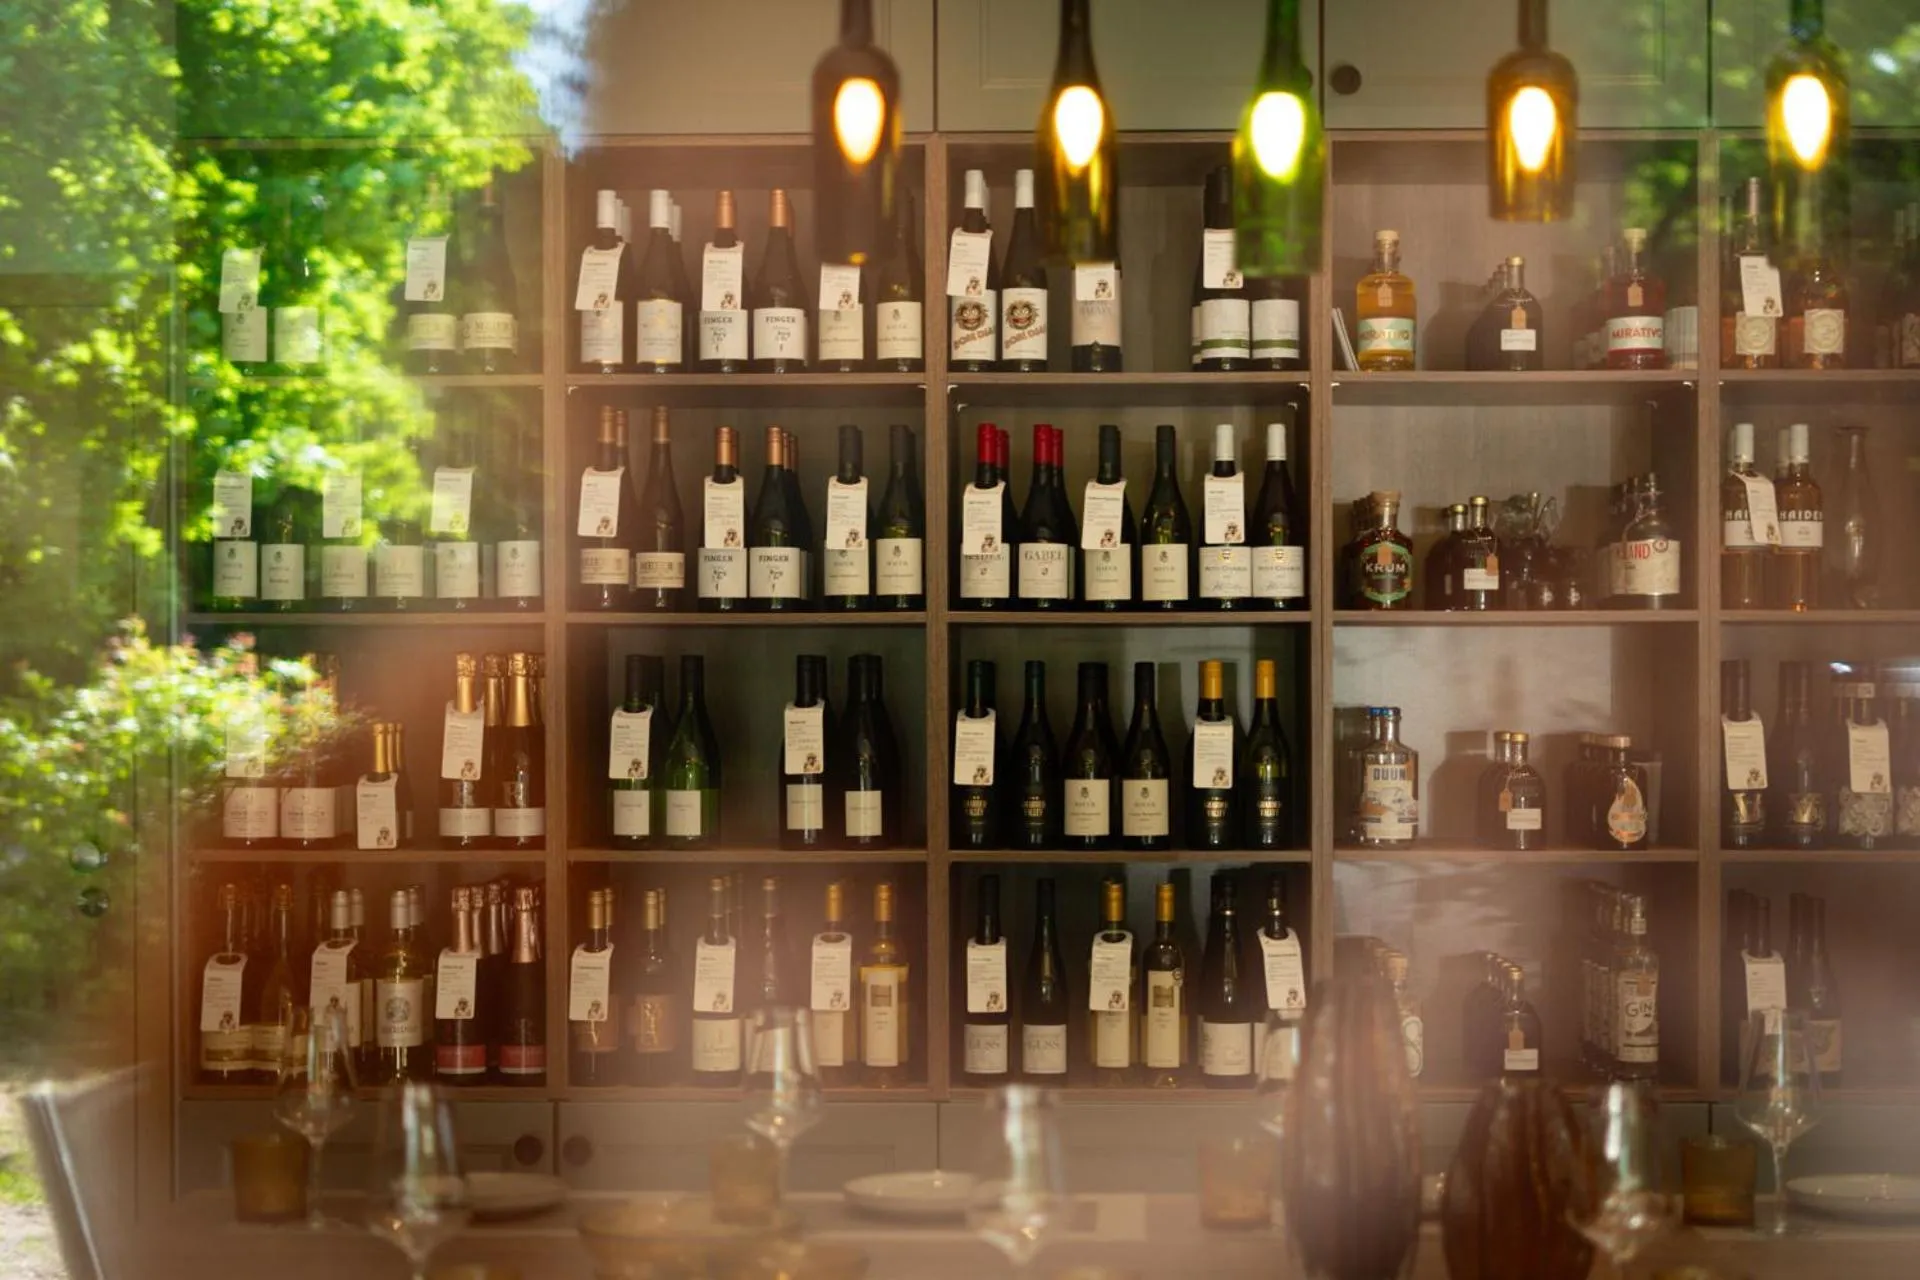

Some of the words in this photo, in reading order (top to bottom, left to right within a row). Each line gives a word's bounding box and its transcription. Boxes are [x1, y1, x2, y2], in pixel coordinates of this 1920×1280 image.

[765, 315, 796, 324] FINGER
[1025, 550, 1065, 561] GABEL
[1365, 562, 1406, 573] KRUM
[1625, 1001, 1652, 1017] GIN
